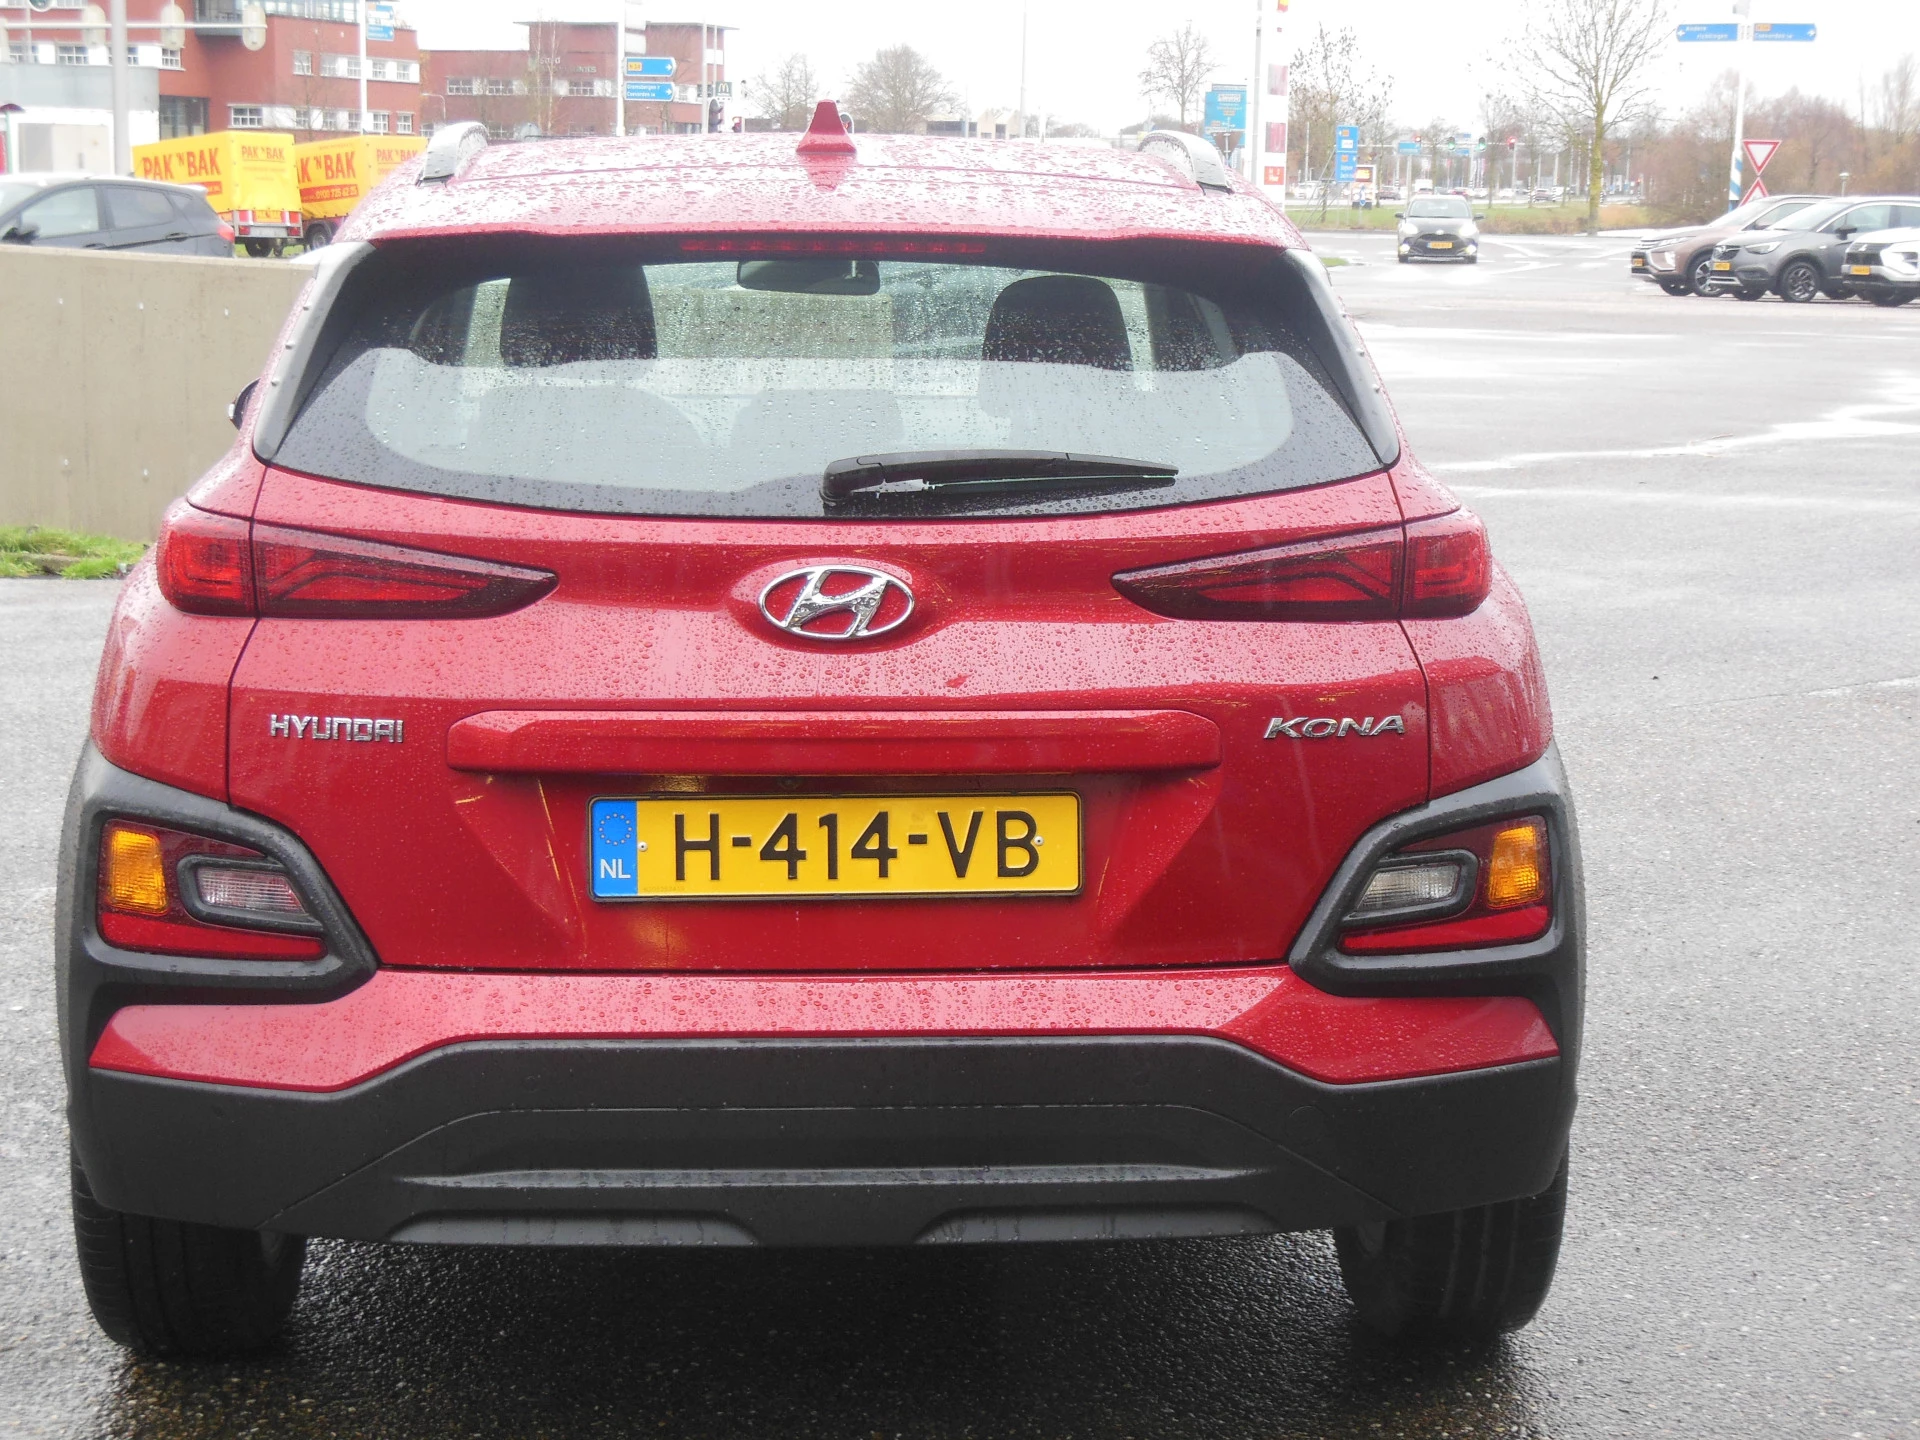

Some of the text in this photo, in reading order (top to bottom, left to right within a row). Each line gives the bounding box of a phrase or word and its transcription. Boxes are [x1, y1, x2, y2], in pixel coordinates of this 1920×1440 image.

[142, 153, 175, 181] PAK
[187, 148, 221, 178] BAK
[242, 146, 259, 159] PAK
[266, 147, 285, 161] BAK
[324, 151, 357, 180] BAK
[377, 149, 394, 162] PAK
[270, 713, 405, 743] HYUNDAI
[1263, 715, 1405, 739] KONA
[674, 811, 1040, 882] H-414-VB
[600, 858, 631, 879] NL
